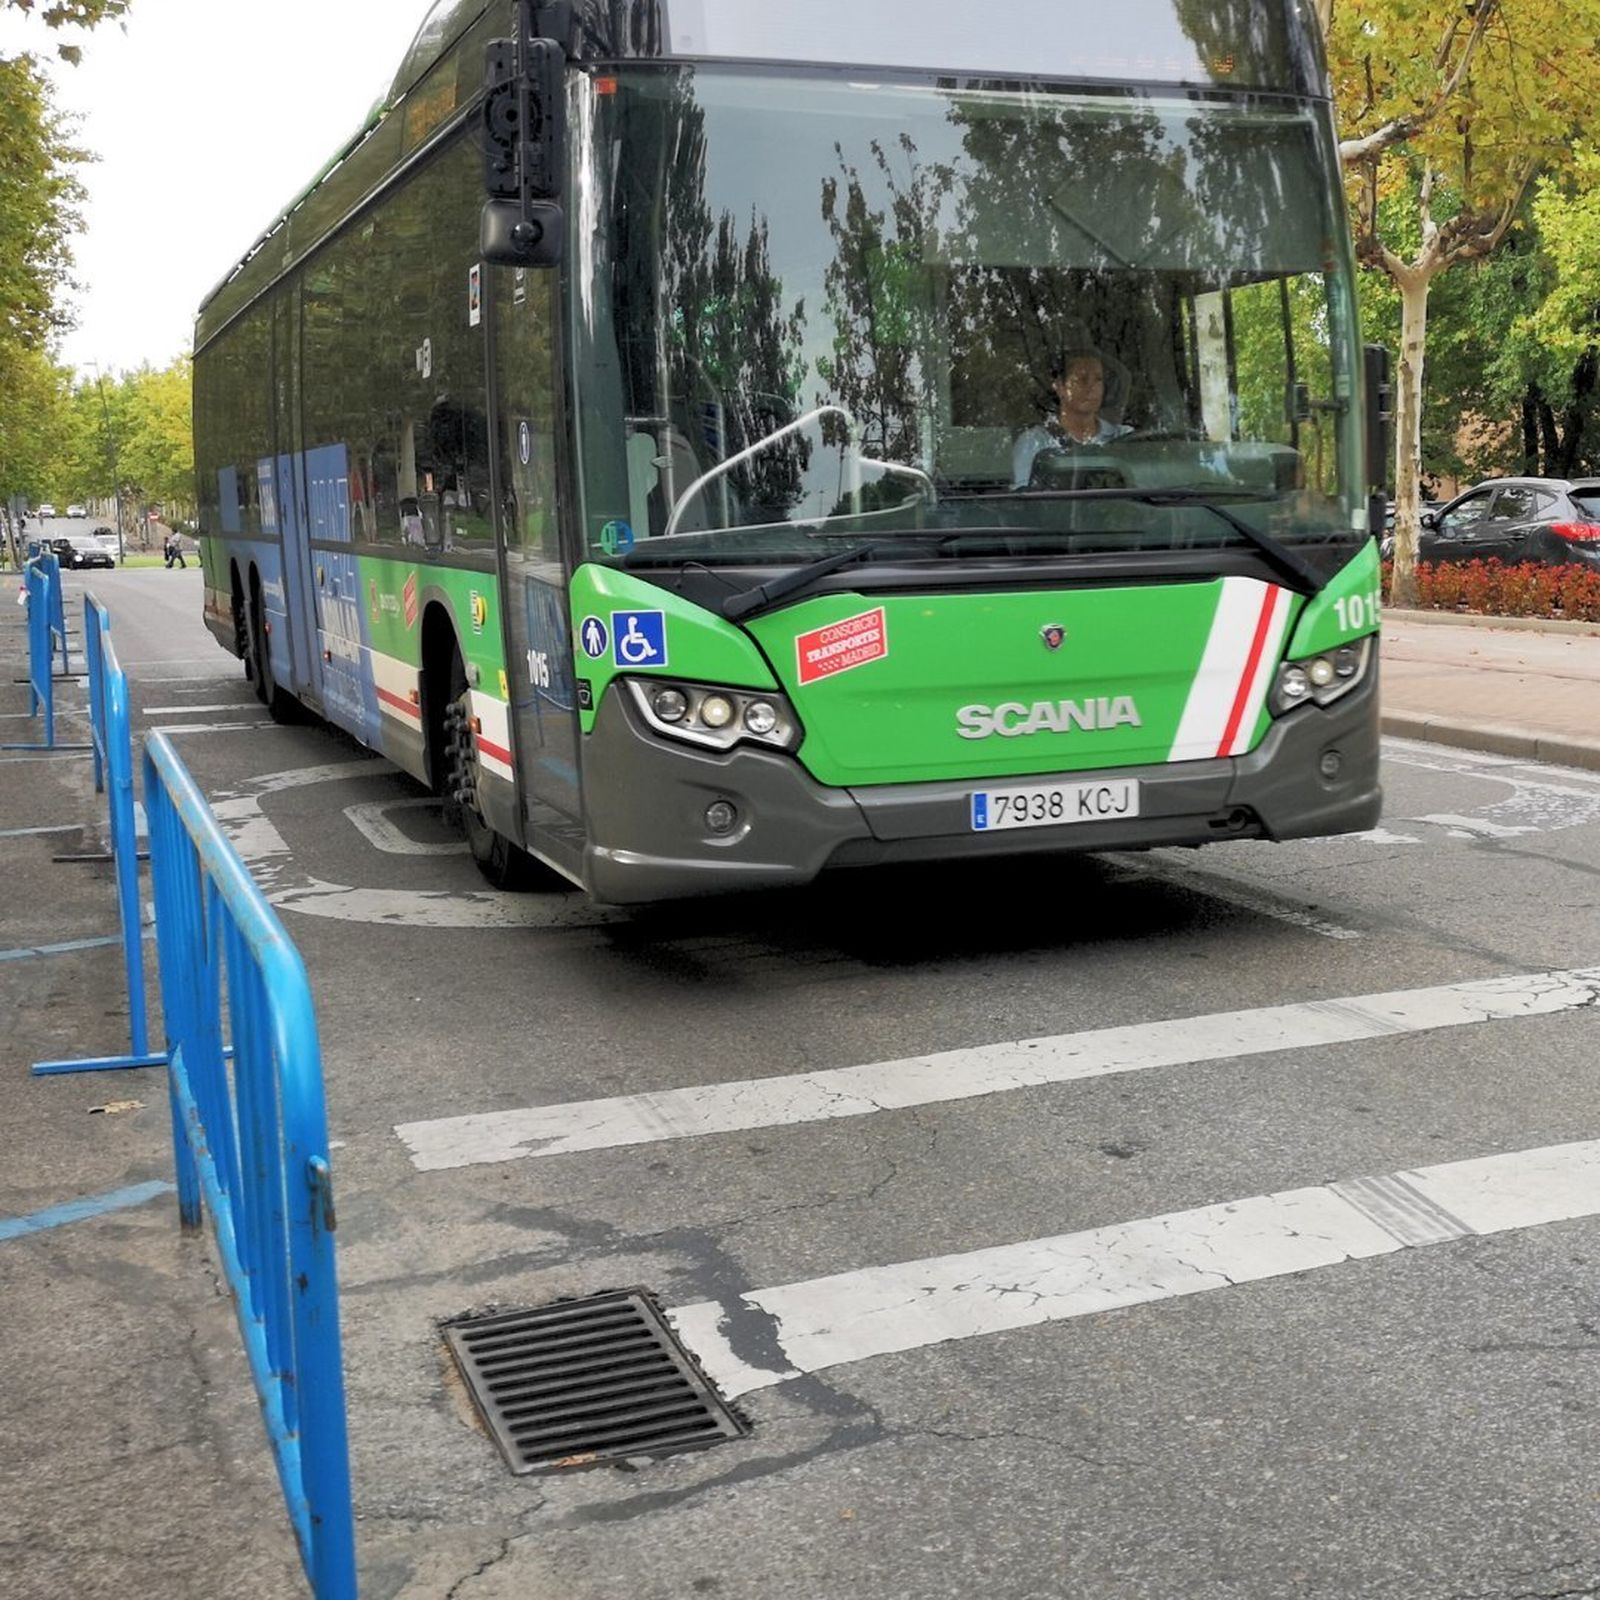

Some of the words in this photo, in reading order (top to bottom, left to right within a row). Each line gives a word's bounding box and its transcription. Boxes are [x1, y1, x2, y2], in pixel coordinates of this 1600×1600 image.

[955, 695, 1142, 739] SCANIA
[994, 791, 1064, 824] 7938
[1078, 786, 1129, 816] KCJ
